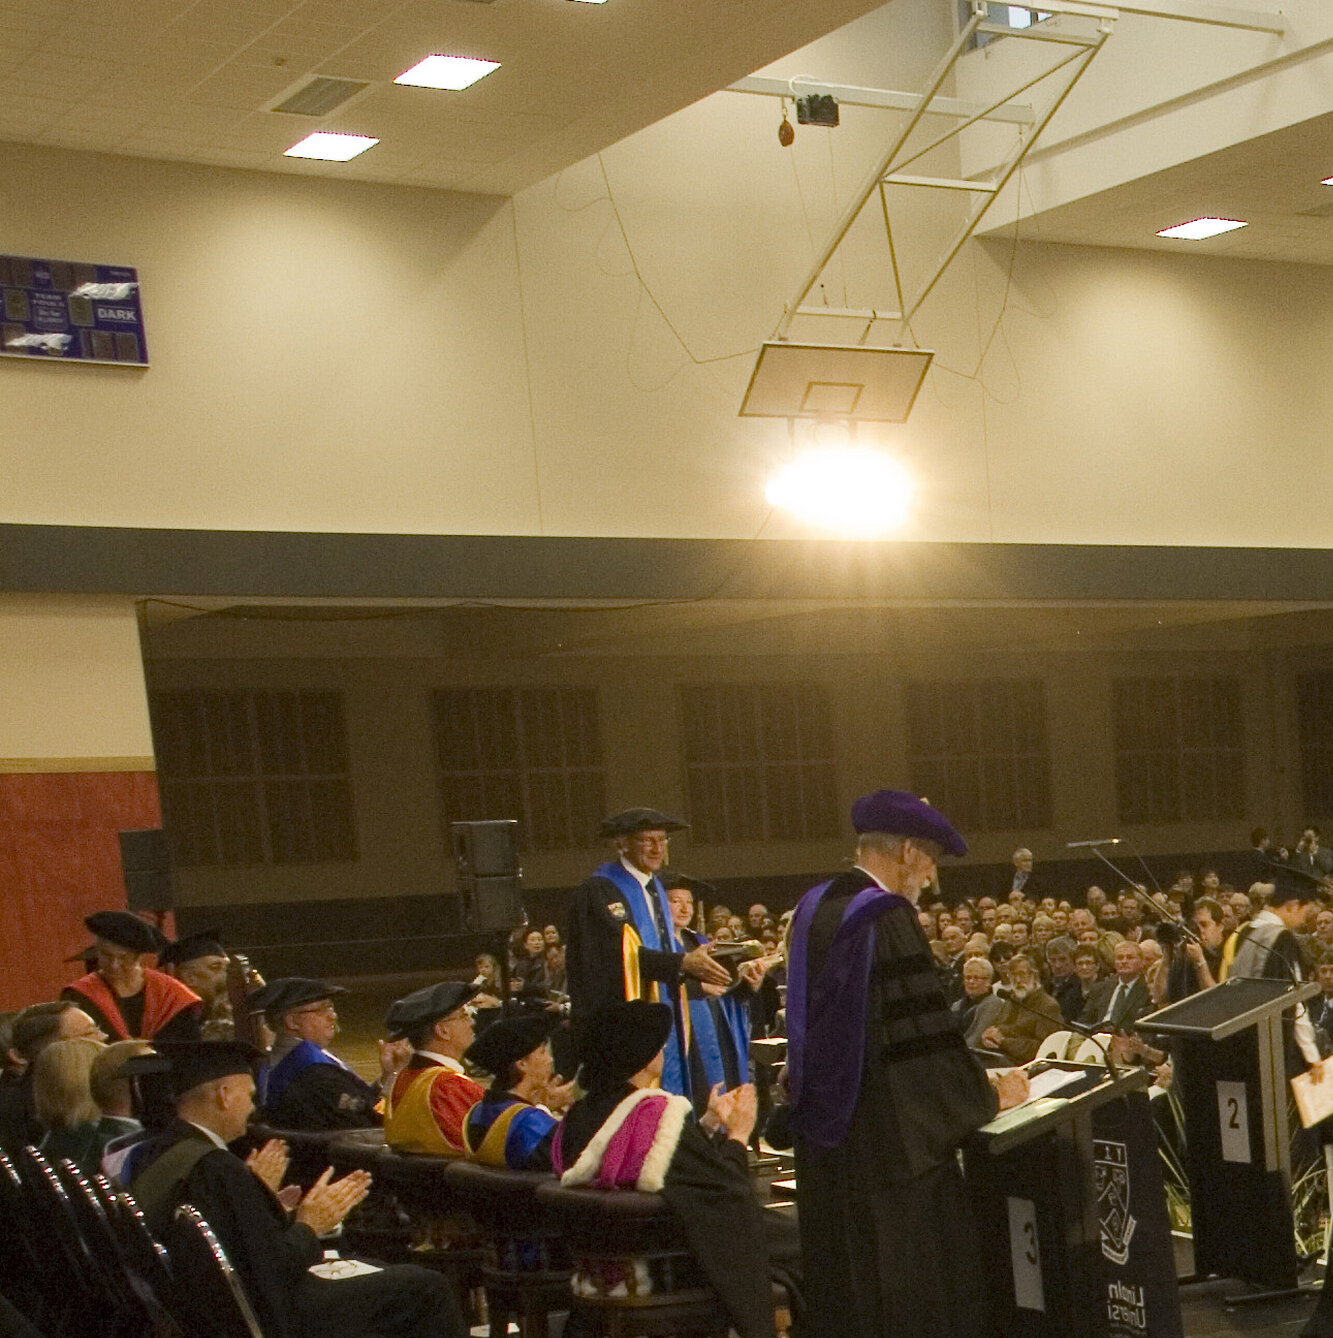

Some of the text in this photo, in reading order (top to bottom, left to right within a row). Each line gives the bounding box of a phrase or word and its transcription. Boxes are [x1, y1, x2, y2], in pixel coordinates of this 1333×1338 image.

[97, 308, 137, 321] DARK
[1227, 1097, 1240, 1129] 2
[1024, 1222, 1037, 1265] 3
